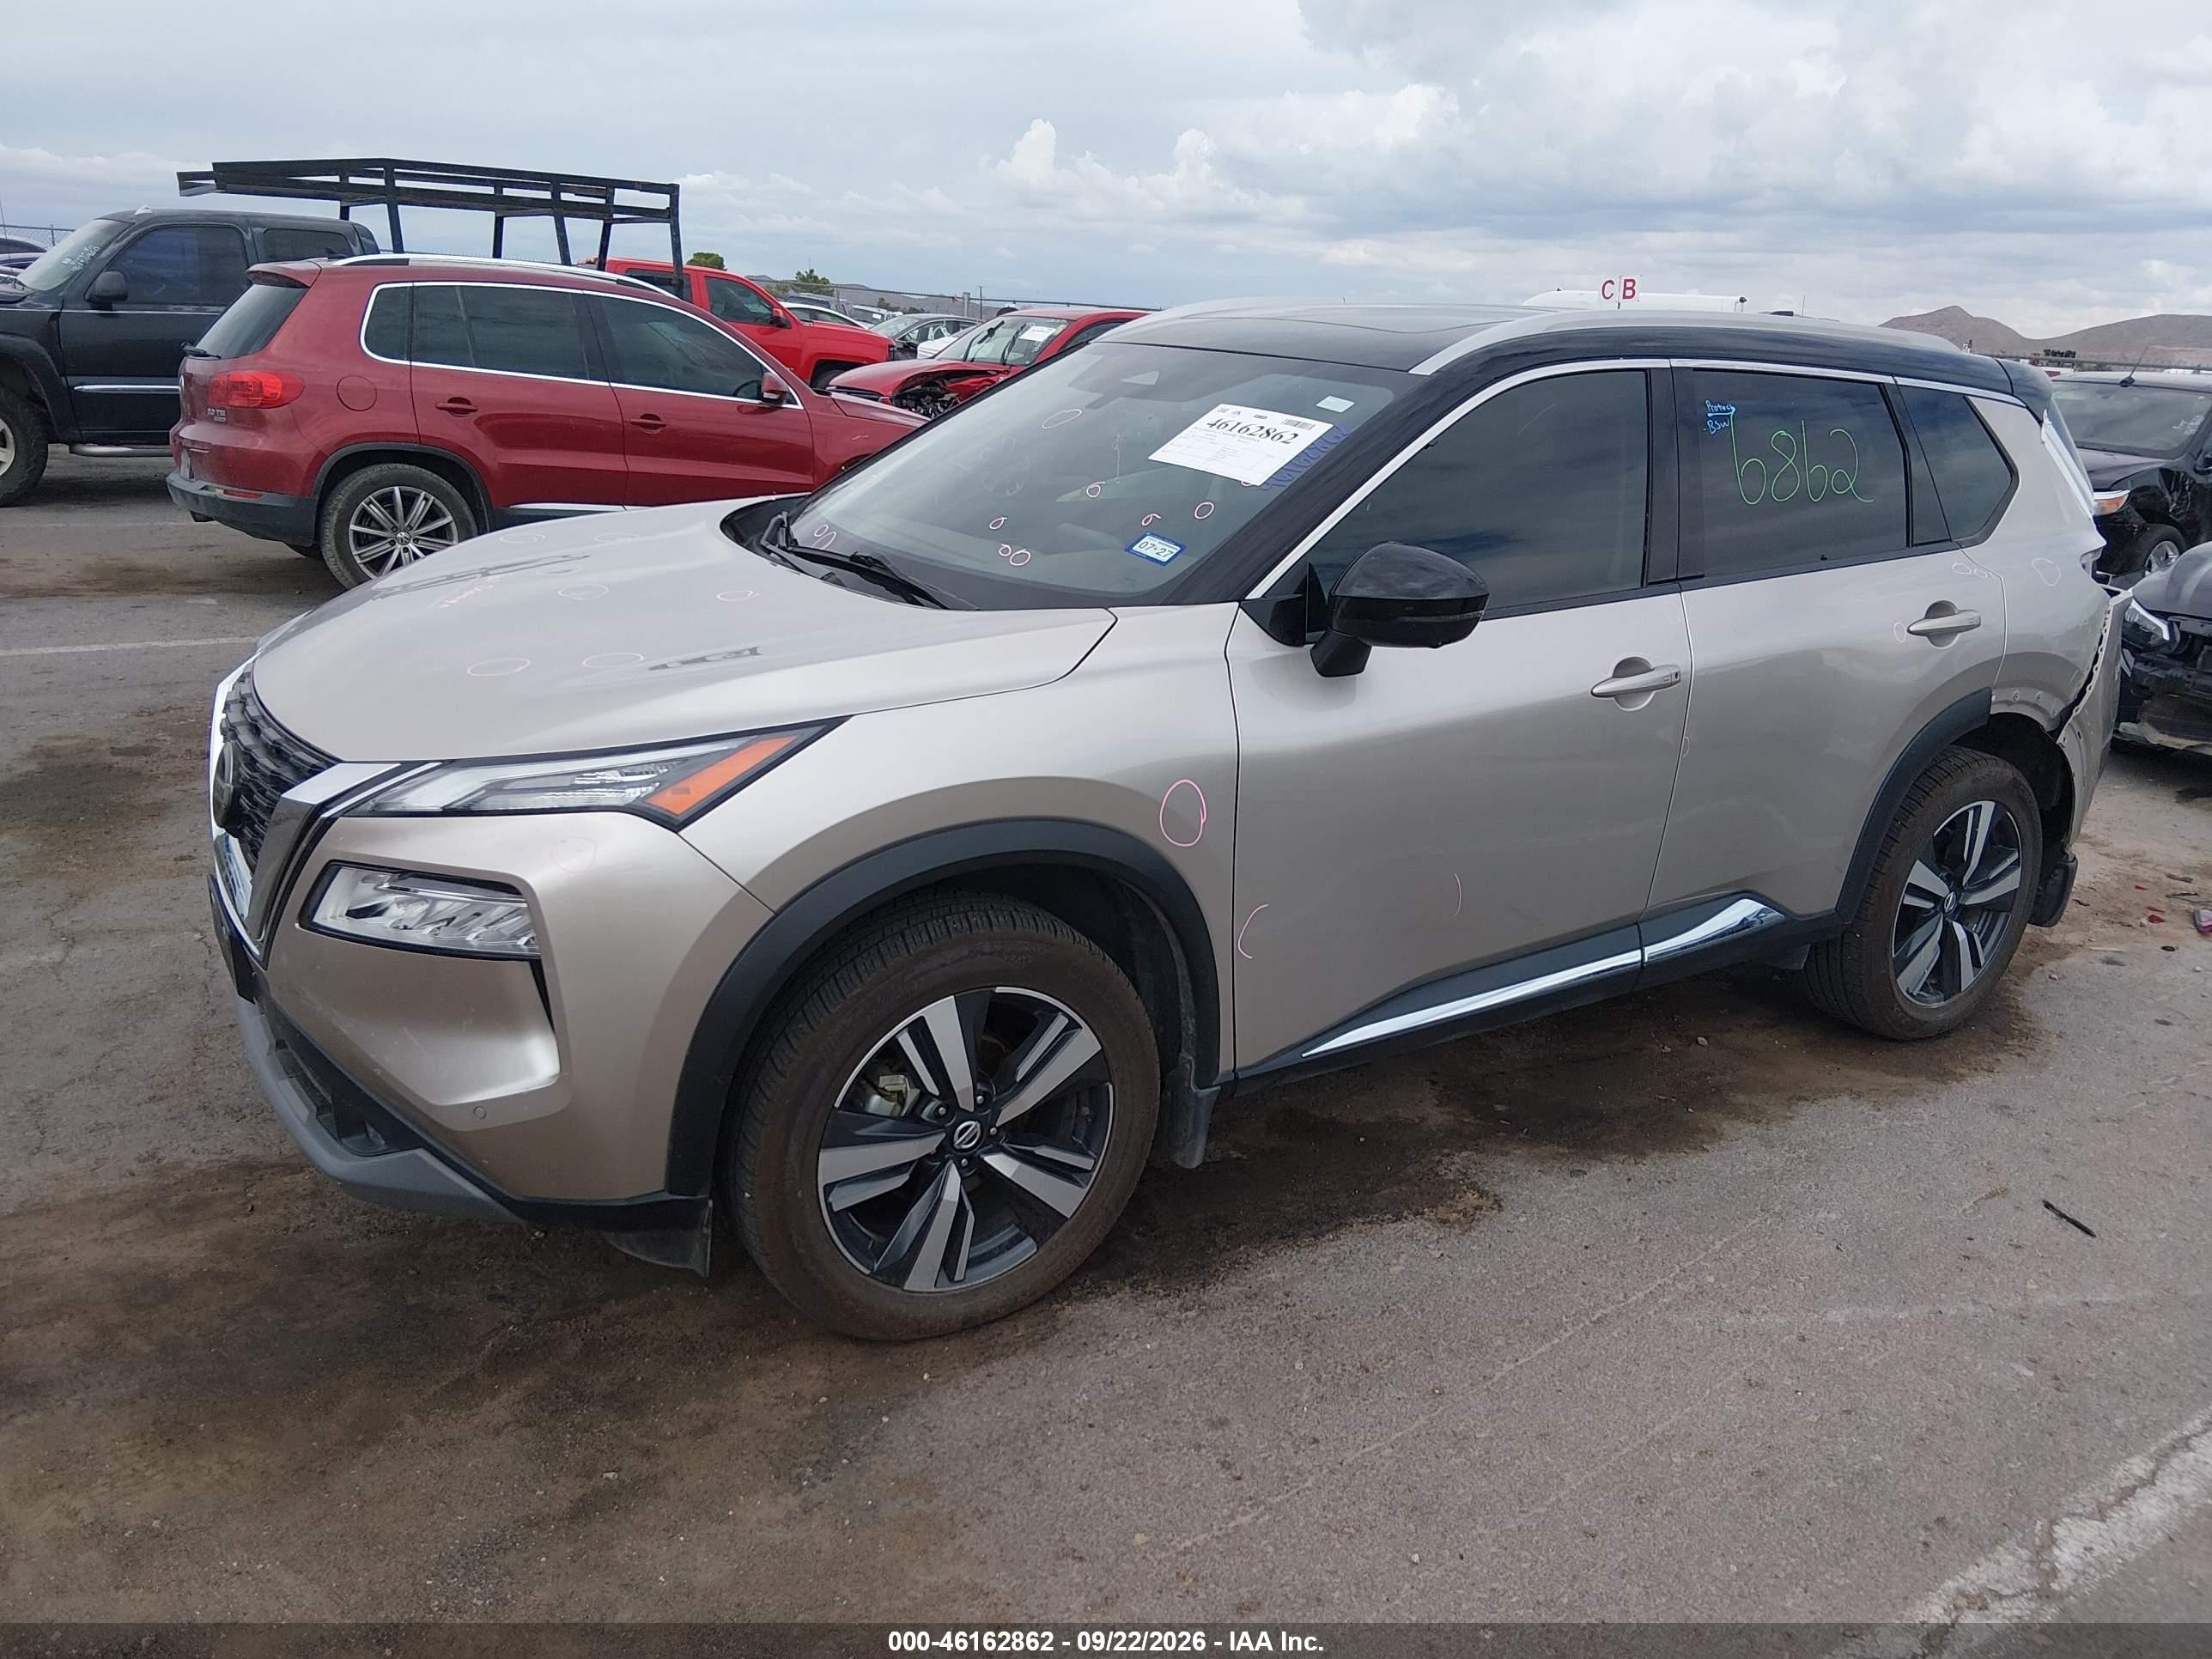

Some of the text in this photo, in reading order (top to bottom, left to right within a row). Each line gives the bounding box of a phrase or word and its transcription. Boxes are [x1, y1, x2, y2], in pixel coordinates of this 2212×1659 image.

[1601, 278, 1637, 301] C B
[1206, 417, 1299, 445] 46162862
[1730, 413, 1875, 506] 6862
